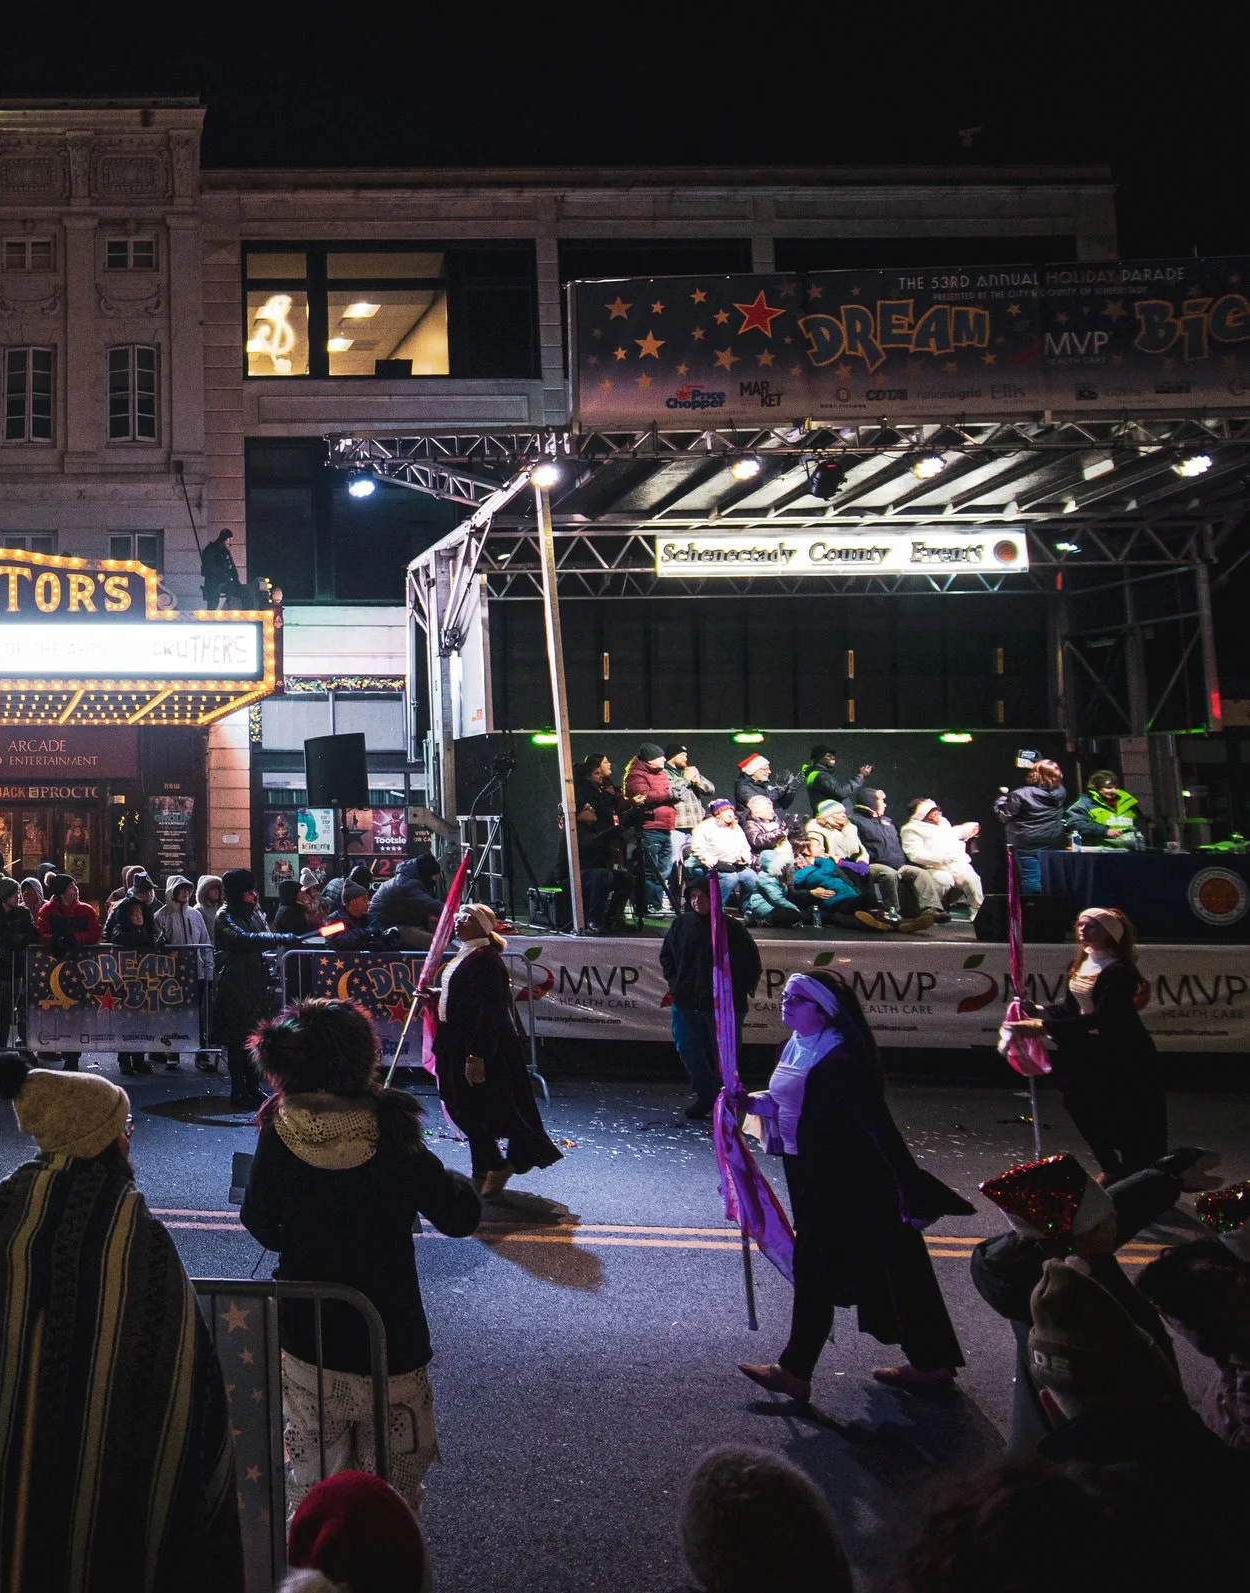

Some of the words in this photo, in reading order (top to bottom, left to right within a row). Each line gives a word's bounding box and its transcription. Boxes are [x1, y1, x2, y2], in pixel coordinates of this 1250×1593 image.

[899, 277, 924, 290] THE
[930, 275, 970, 289] 53RD
[976, 272, 1039, 287] ANNUAL
[1122, 267, 1186, 282] PARADE
[934, 292, 975, 301] PRESENTED
[978, 291, 988, 300] BY
[990, 291, 1006, 299] THE
[1007, 289, 1029, 298] CITY
[1040, 287, 1077, 298] COUNTY
[798, 299, 991, 373] DREAM
[1043, 331, 1110, 356] MVP
[691, 389, 726, 400] Price
[740, 381, 769, 397] MAR
[917, 387, 982, 400] nationalgrid
[990, 383, 1026, 400] Ellis
[666, 397, 726, 410] Chopper
[761, 393, 783, 408] KET
[661, 541, 797, 565] Schenectady
[809, 541, 891, 565] County
[910, 541, 984, 563] Events
[8, 739, 67, 752] ARCADE
[10, 755, 98, 766] ENTERTAINMENT
[374, 836, 407, 844] Tootsie
[77, 950, 176, 991] DREAM
[558, 965, 639, 996] MVP
[852, 971, 937, 1001] MVP
[1004, 973, 1064, 1003] MV
[1157, 974, 1248, 1006] MVP
[559, 997, 603, 1008] HEALTH
[608, 999, 638, 1009] CARE
[862, 1004, 898, 1014] EALTH
[902, 1005, 934, 1015] CARE
[535, 1014, 621, 1025] www.mvphealthcare.com
[1161, 1009, 1207, 1018] HEALTH
[1212, 1009, 1244, 1018] CARE
